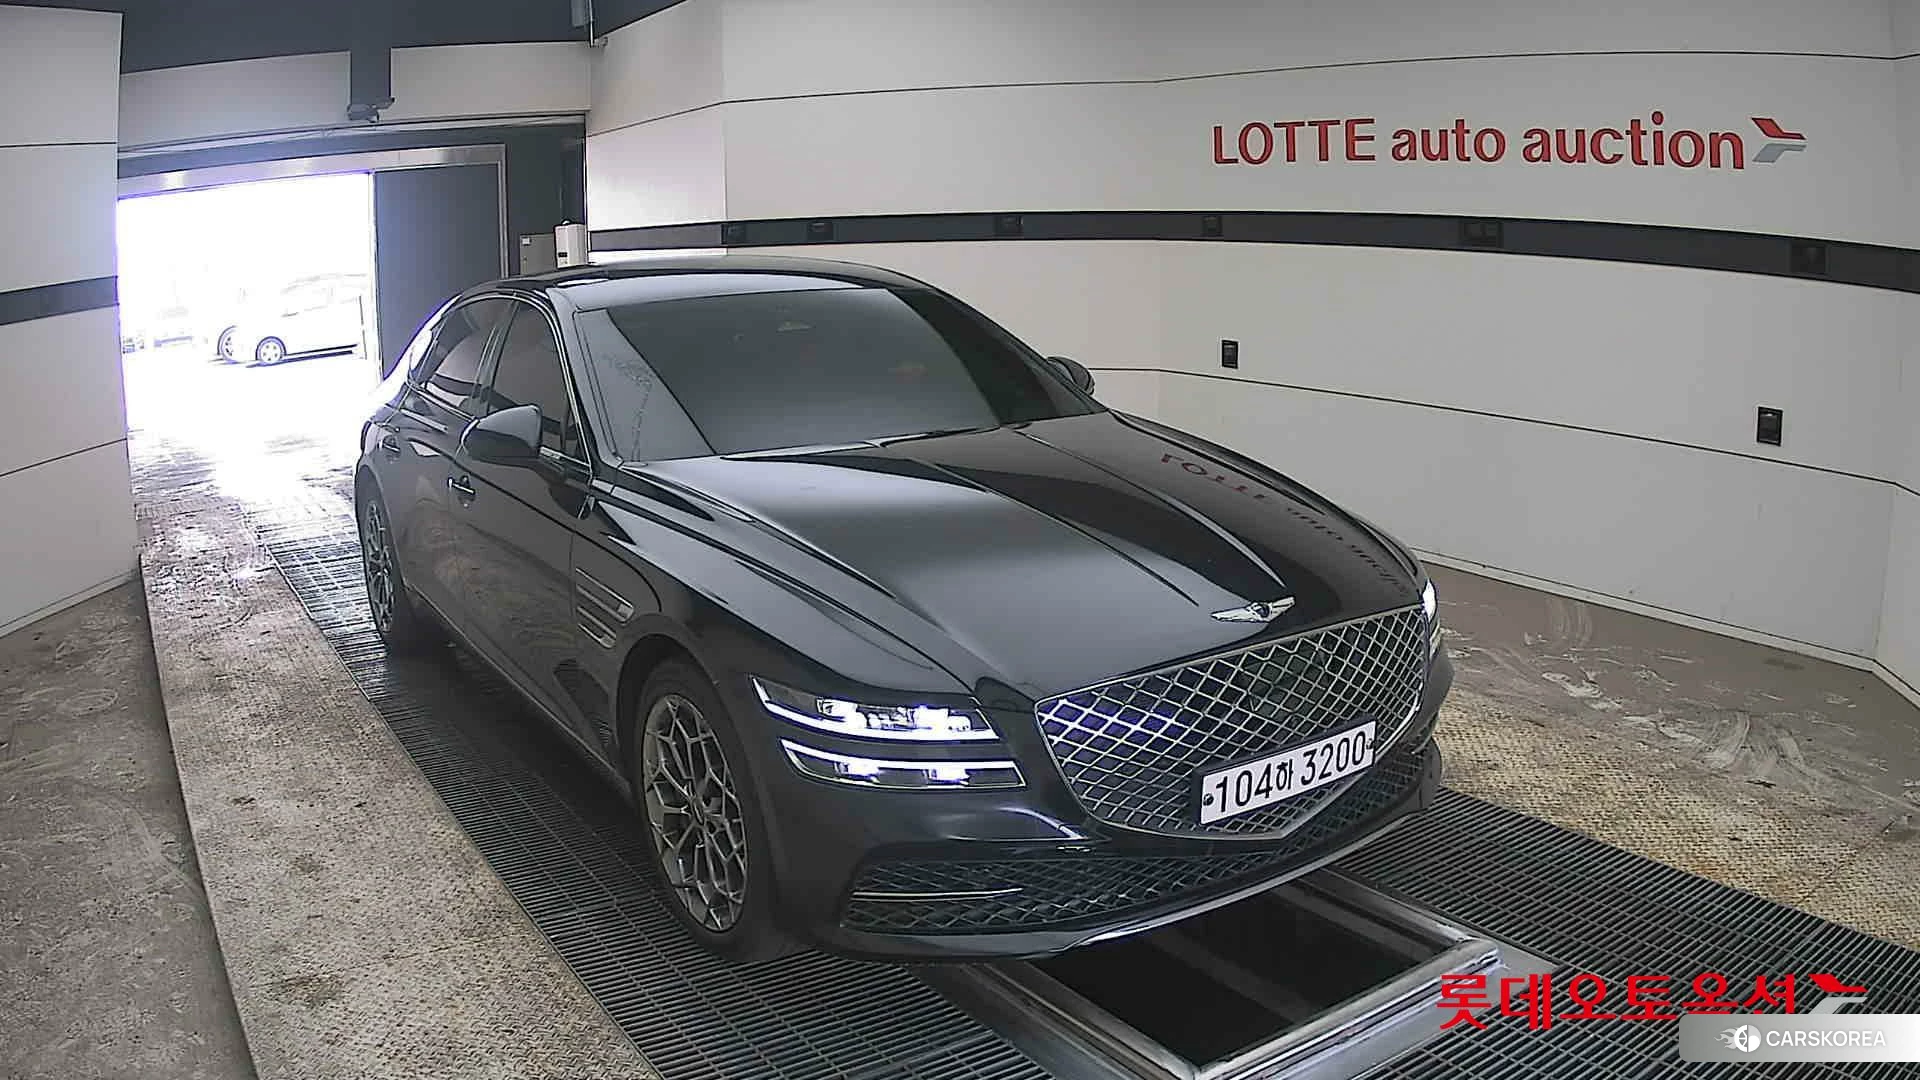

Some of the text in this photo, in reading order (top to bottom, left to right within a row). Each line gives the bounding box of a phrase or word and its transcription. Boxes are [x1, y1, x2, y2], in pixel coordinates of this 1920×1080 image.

[1212, 111, 1745, 170] LOTTE auto auction
[1216, 731, 1366, 813] 104하 3200
